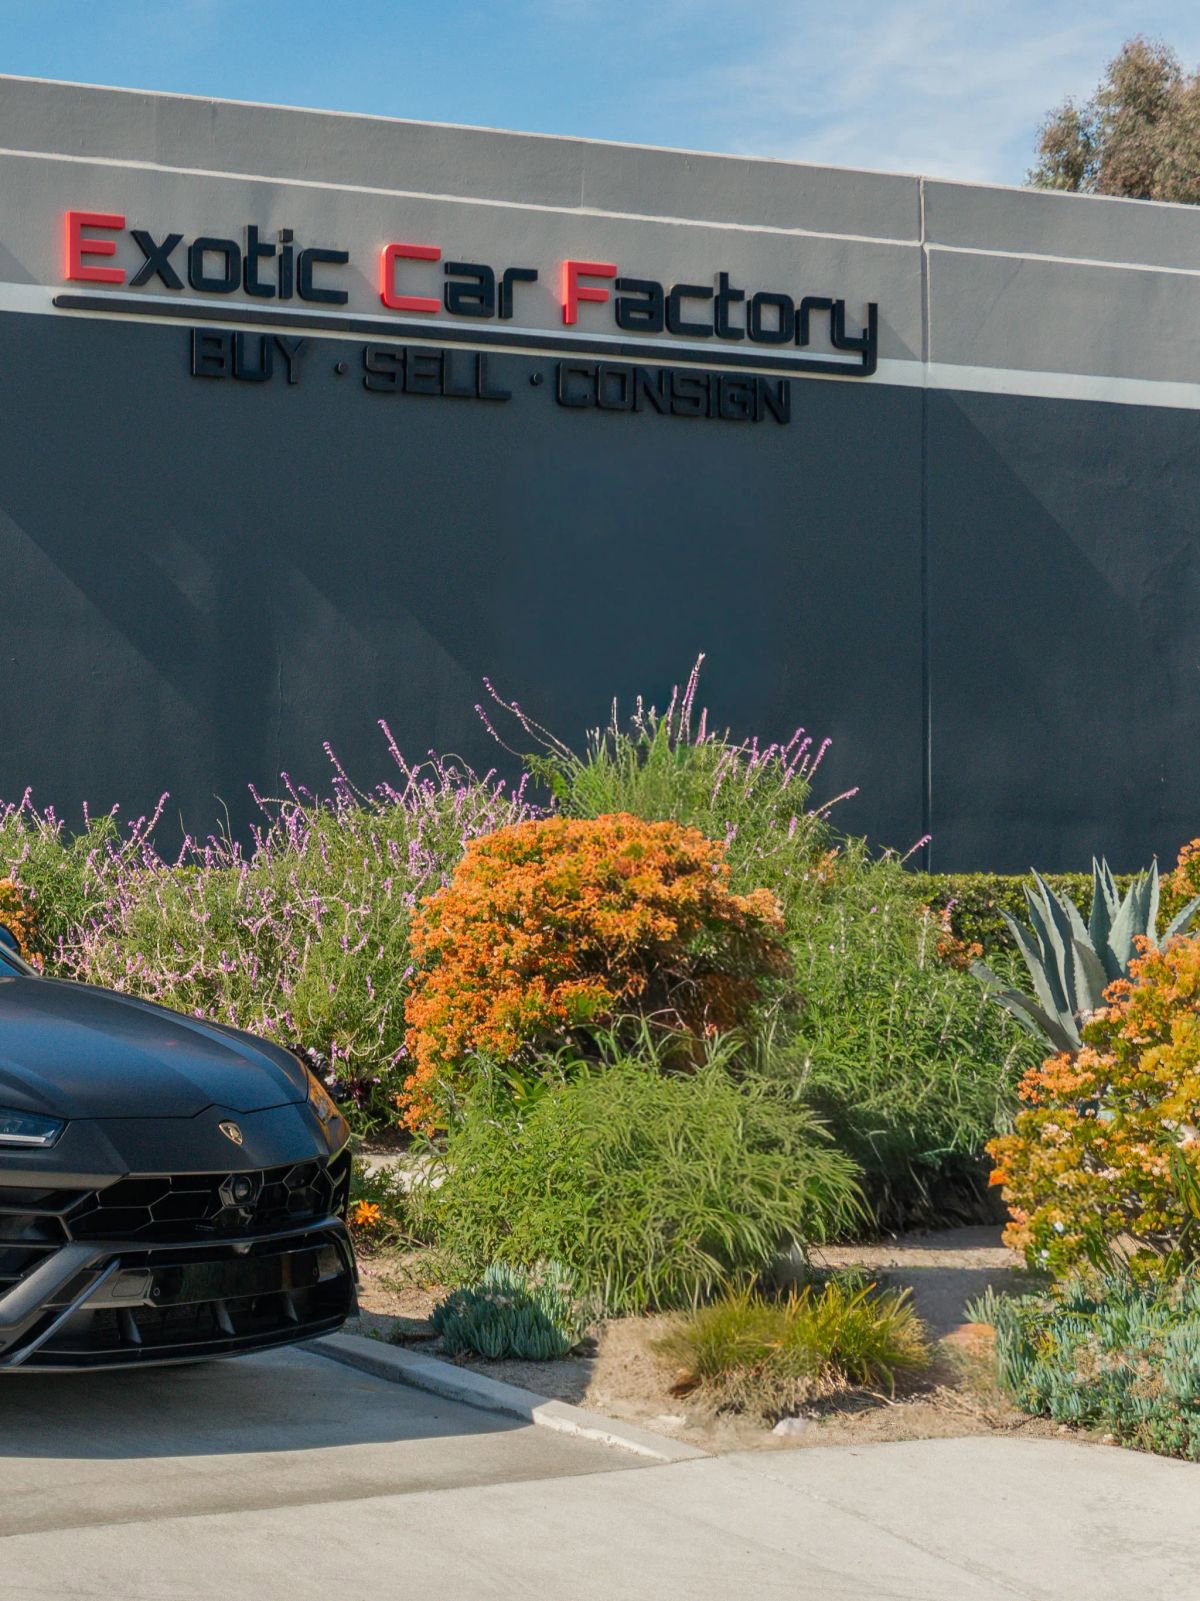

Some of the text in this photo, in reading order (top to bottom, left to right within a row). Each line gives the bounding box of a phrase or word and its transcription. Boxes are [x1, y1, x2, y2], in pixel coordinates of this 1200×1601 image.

[64, 210, 878, 376] Exotic Car Factory
[190, 327, 791, 424] BUY SELL CONSIGN
